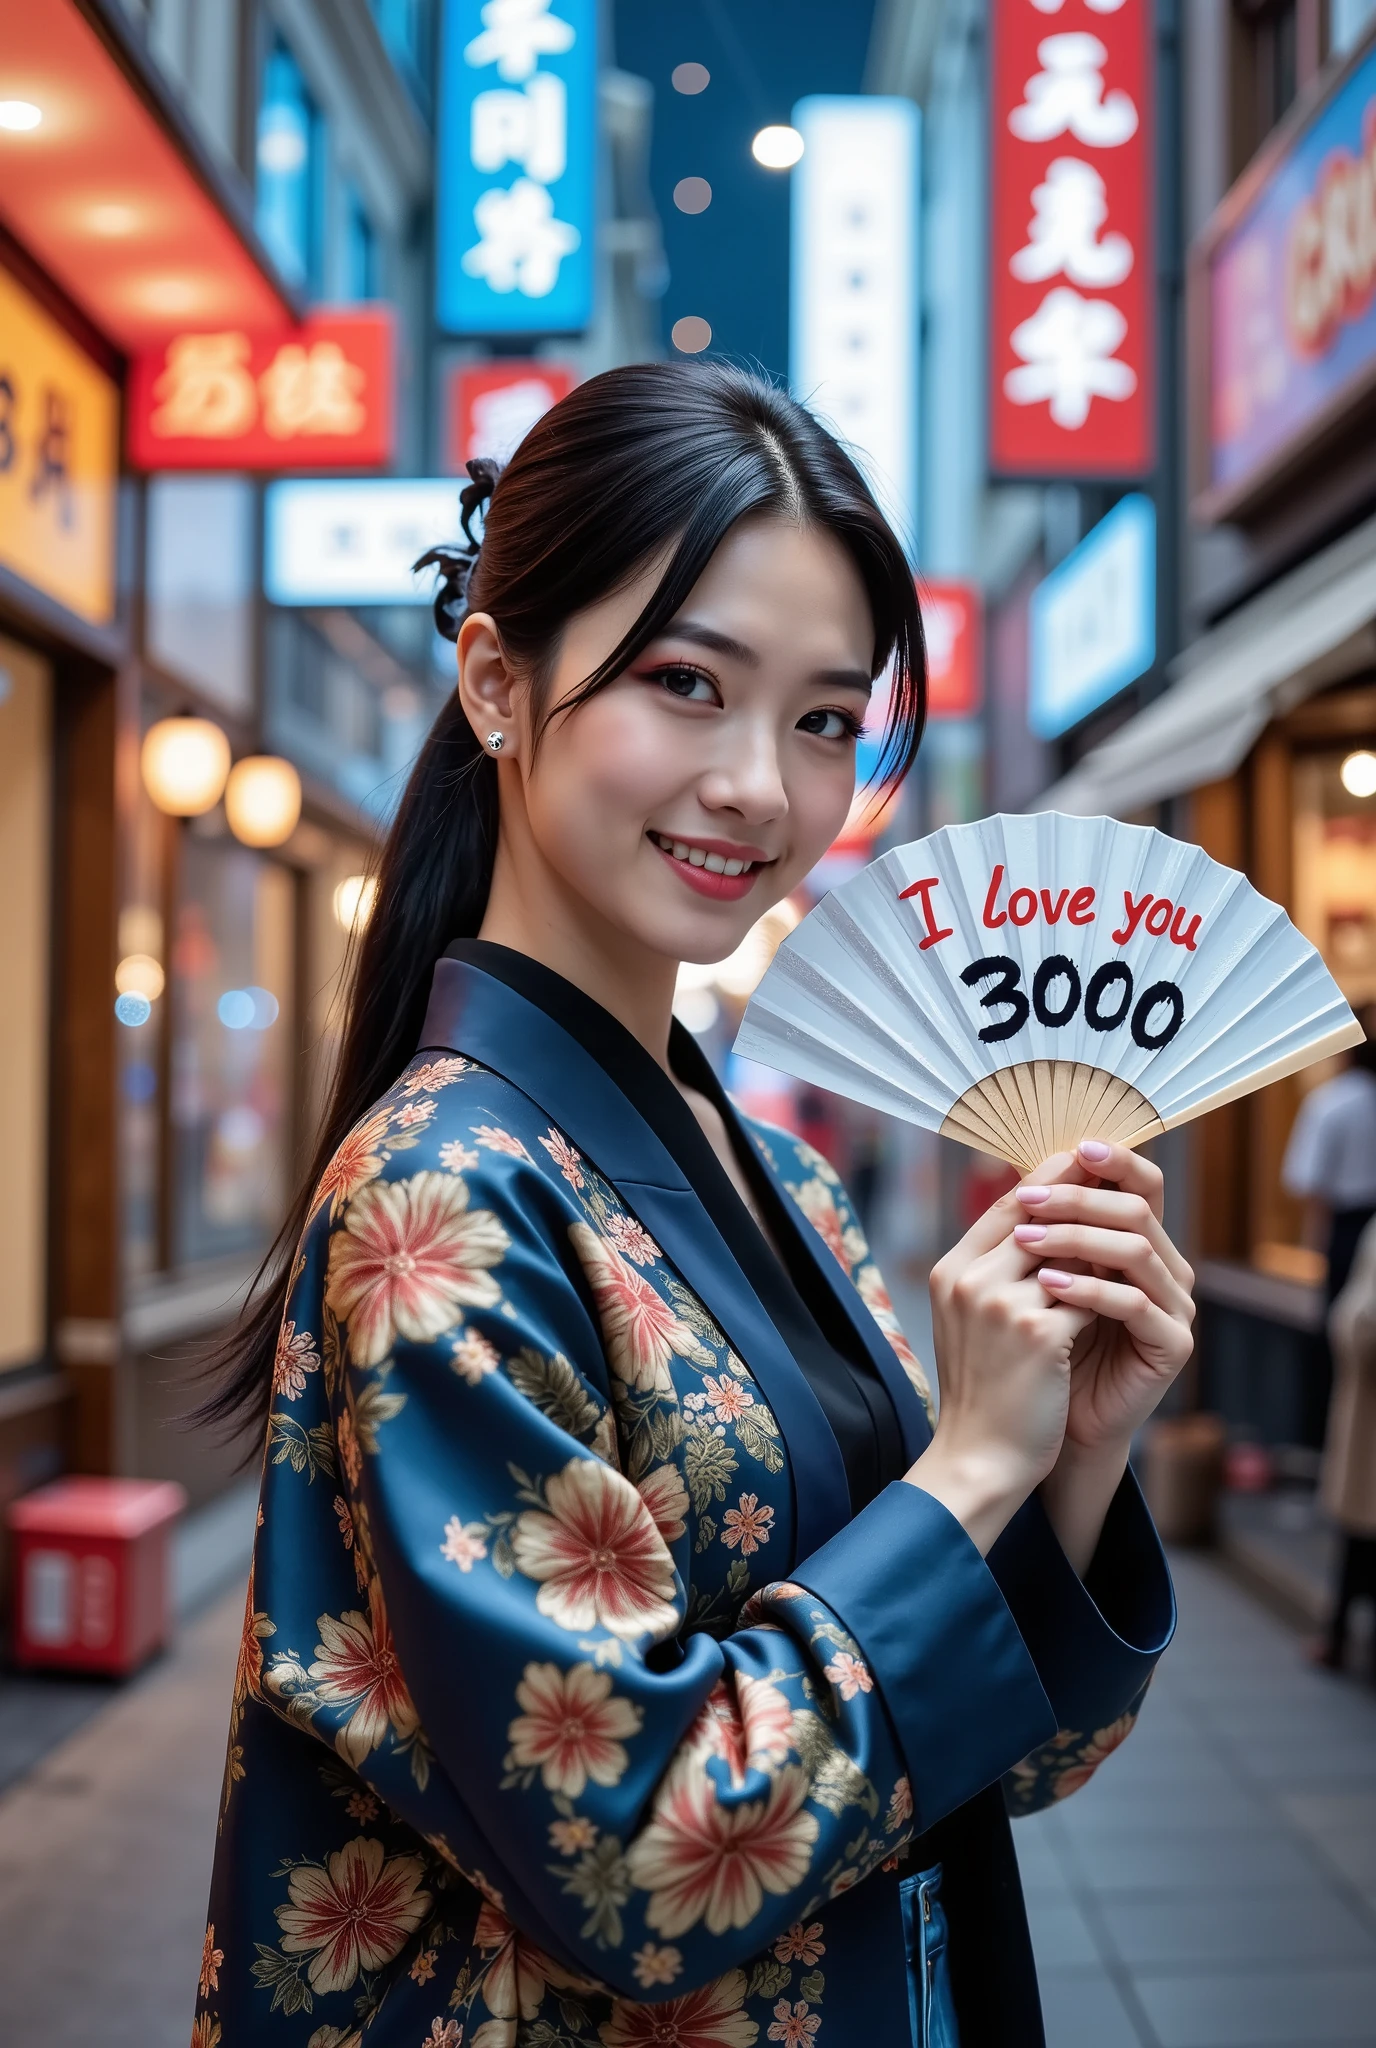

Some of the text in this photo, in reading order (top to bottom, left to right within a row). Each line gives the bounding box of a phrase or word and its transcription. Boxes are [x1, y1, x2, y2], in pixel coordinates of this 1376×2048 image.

[898, 864, 1203, 952] I love you
[958, 954, 1186, 1054] 3000
